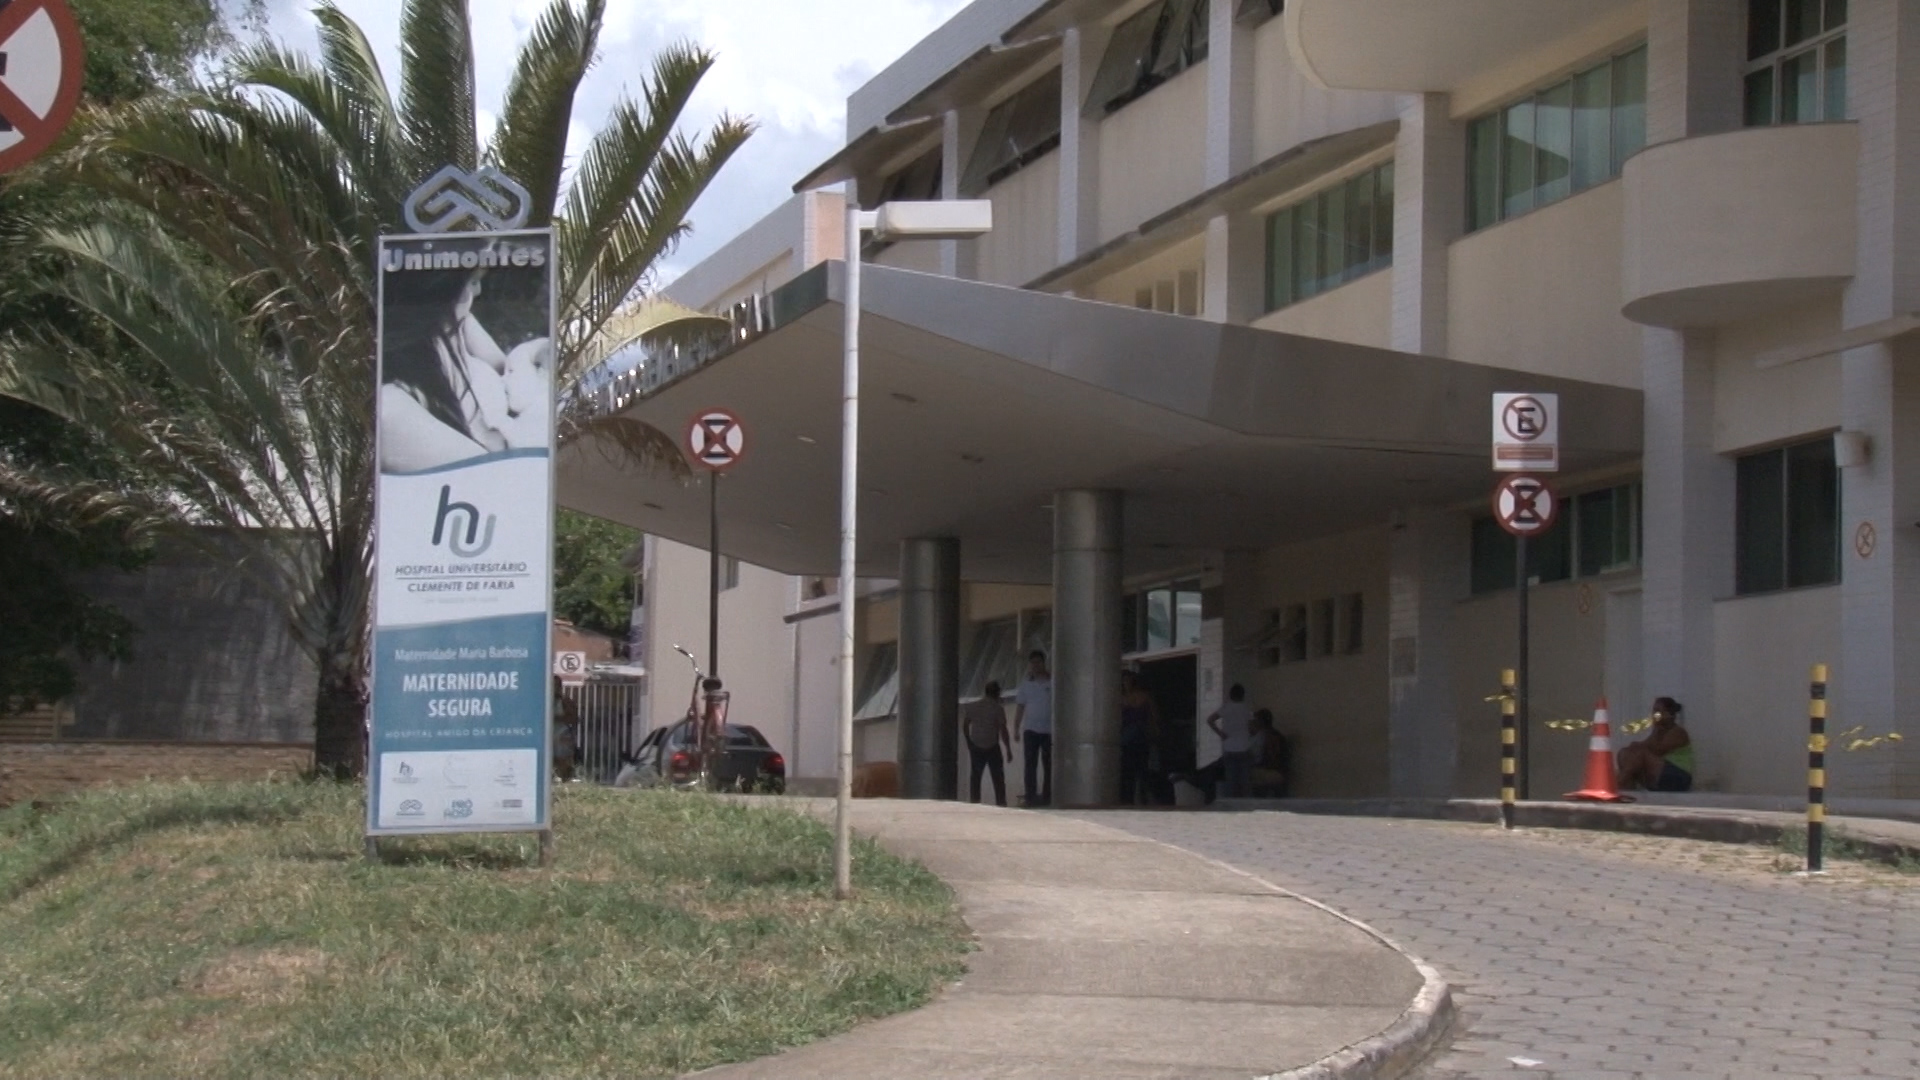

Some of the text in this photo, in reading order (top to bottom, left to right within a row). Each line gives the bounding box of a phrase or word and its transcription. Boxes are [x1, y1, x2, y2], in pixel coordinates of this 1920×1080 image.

[382, 241, 546, 272] Unimontes
[395, 565, 444, 575] HOSPITAL
[407, 580, 515, 592] CLEMENTE DE FARIA
[403, 671, 519, 692] MATERNIDADE
[428, 698, 492, 718] SEGURA
